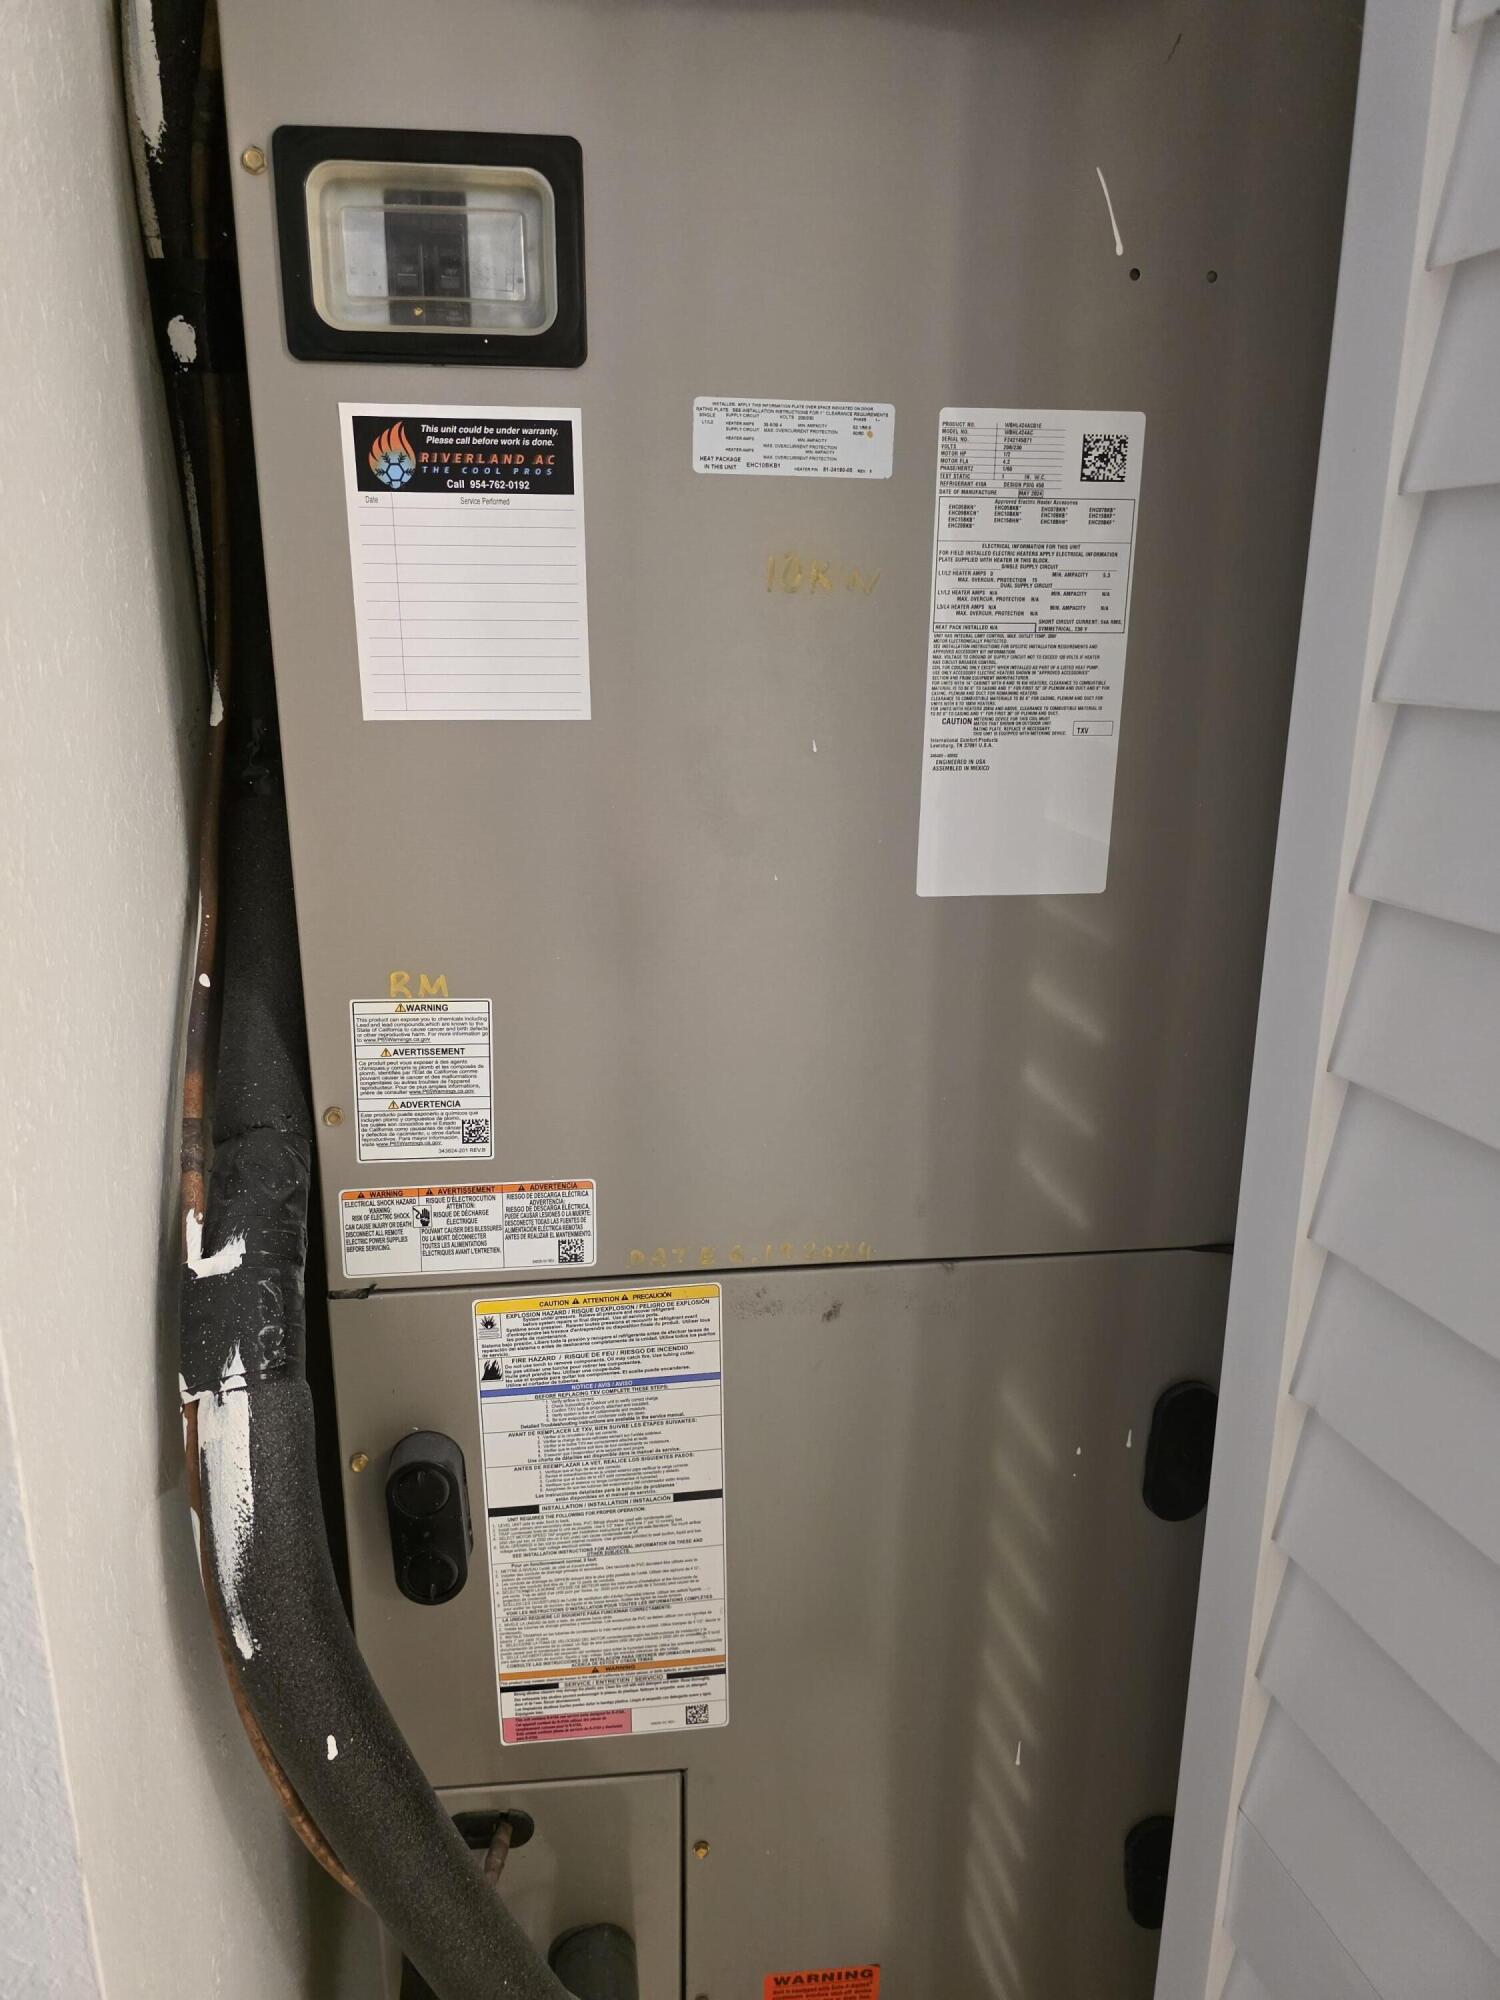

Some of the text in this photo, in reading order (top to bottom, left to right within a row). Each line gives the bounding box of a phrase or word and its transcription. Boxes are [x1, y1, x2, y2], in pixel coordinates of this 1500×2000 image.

[421, 425, 558, 436] This unit could be under warranty.
[426, 437, 453, 445] Please
[456, 437, 470, 445] call
[472, 437, 498, 445] before
[500, 438, 520, 446] work
[532, 438, 554, 446] done.
[420, 453, 555, 465] RIVERLAND AC
[447, 480, 530, 489] Call 954-762-0192
[390, 971, 448, 998] RM
[400, 1100, 461, 1108] ADVERTENCIA
[633, 1292, 672, 1300] PRECAUCIÓN
[633, 1495, 671, 1503] INSTALACIÓN
[774, 1969, 873, 1985] WARNING
